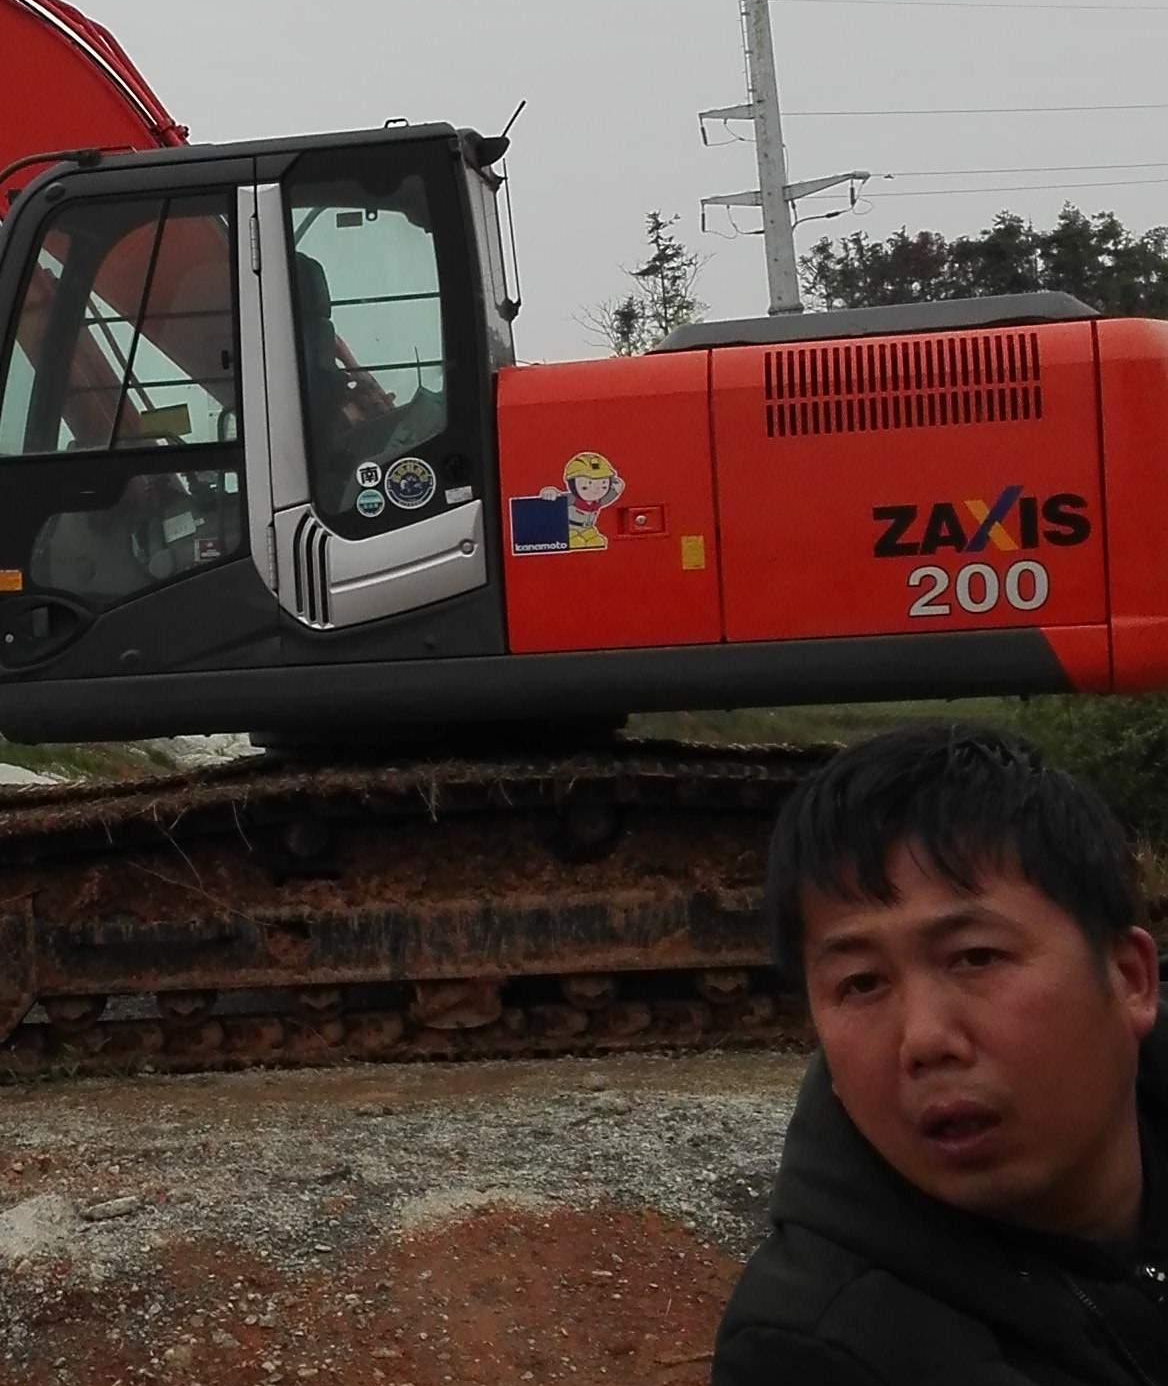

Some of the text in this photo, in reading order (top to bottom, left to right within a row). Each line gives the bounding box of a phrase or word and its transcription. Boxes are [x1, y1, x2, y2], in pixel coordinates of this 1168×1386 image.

[359, 466, 379, 484] 南
[872, 485, 1092, 558] ZAXIS
[514, 541, 568, 552] kanamoto
[907, 559, 1050, 617] 200
